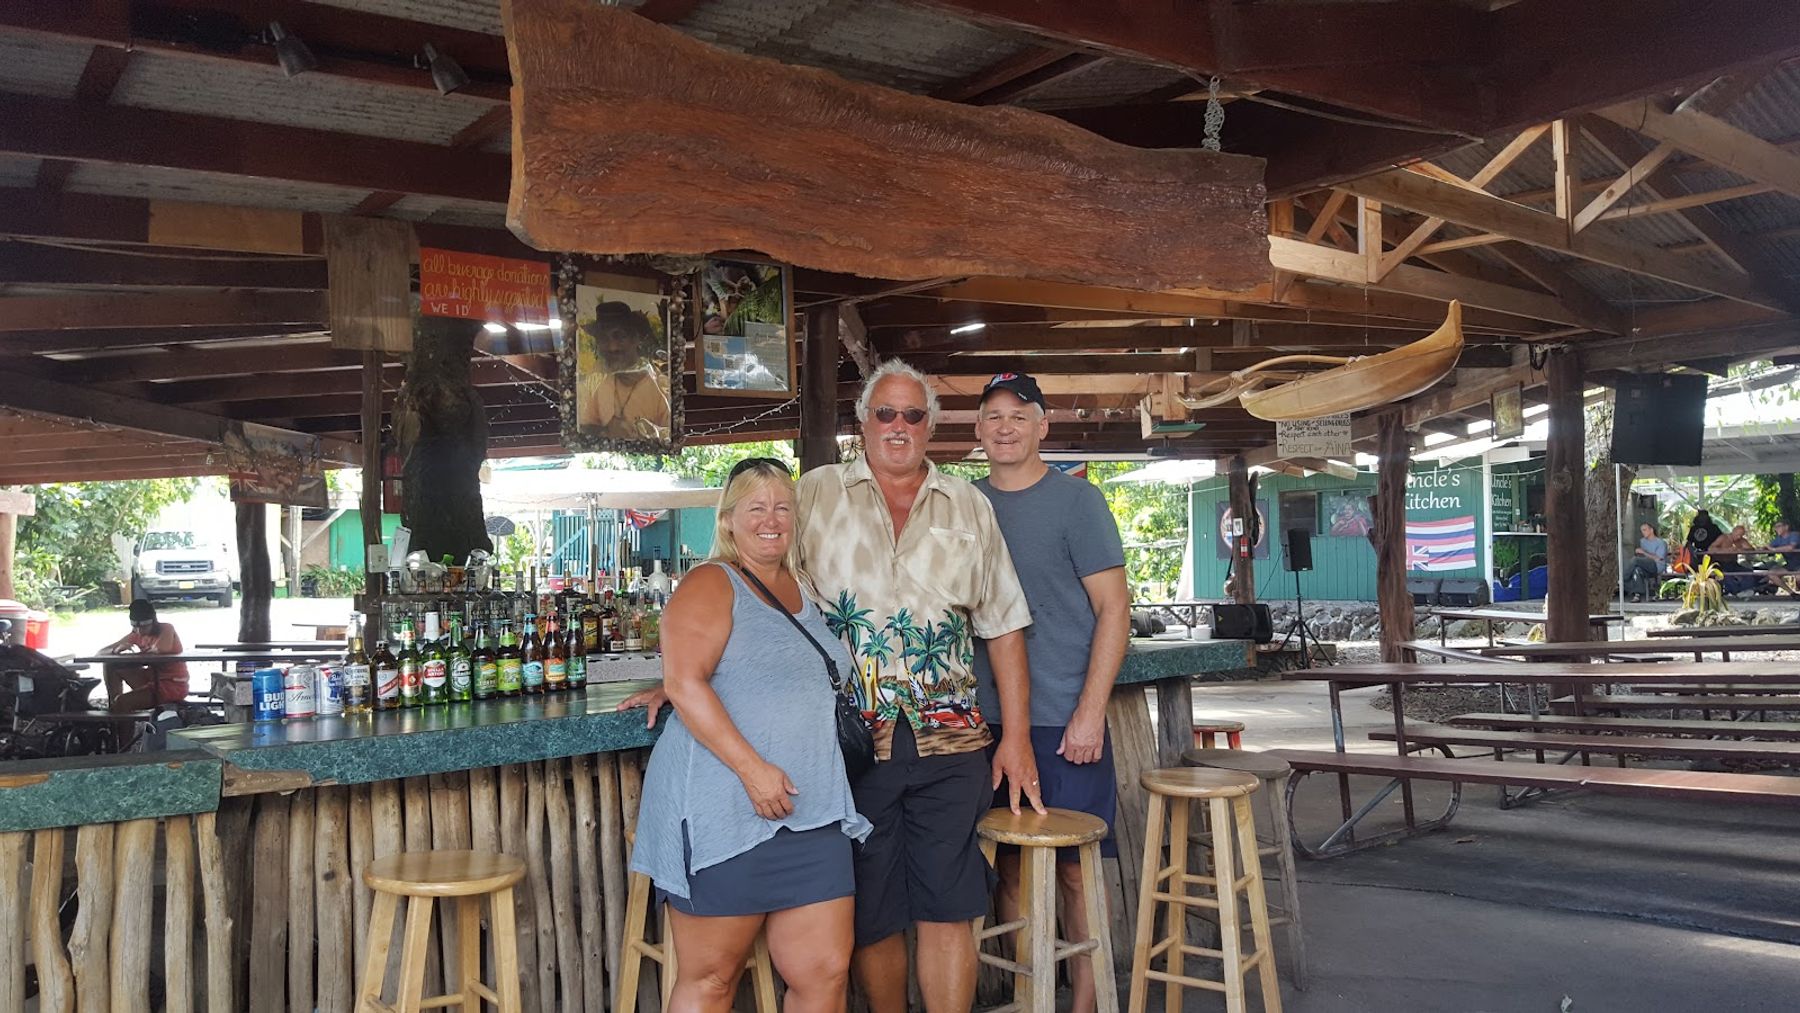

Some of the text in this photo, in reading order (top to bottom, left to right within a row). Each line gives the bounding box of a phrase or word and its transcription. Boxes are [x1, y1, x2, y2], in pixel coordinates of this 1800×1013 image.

[423, 254, 549, 287] all beverage donations
[425, 283, 449, 297] are
[452, 278, 491, 311] highly
[430, 302, 448, 314] WE
[259, 701, 284, 711] LIGH
